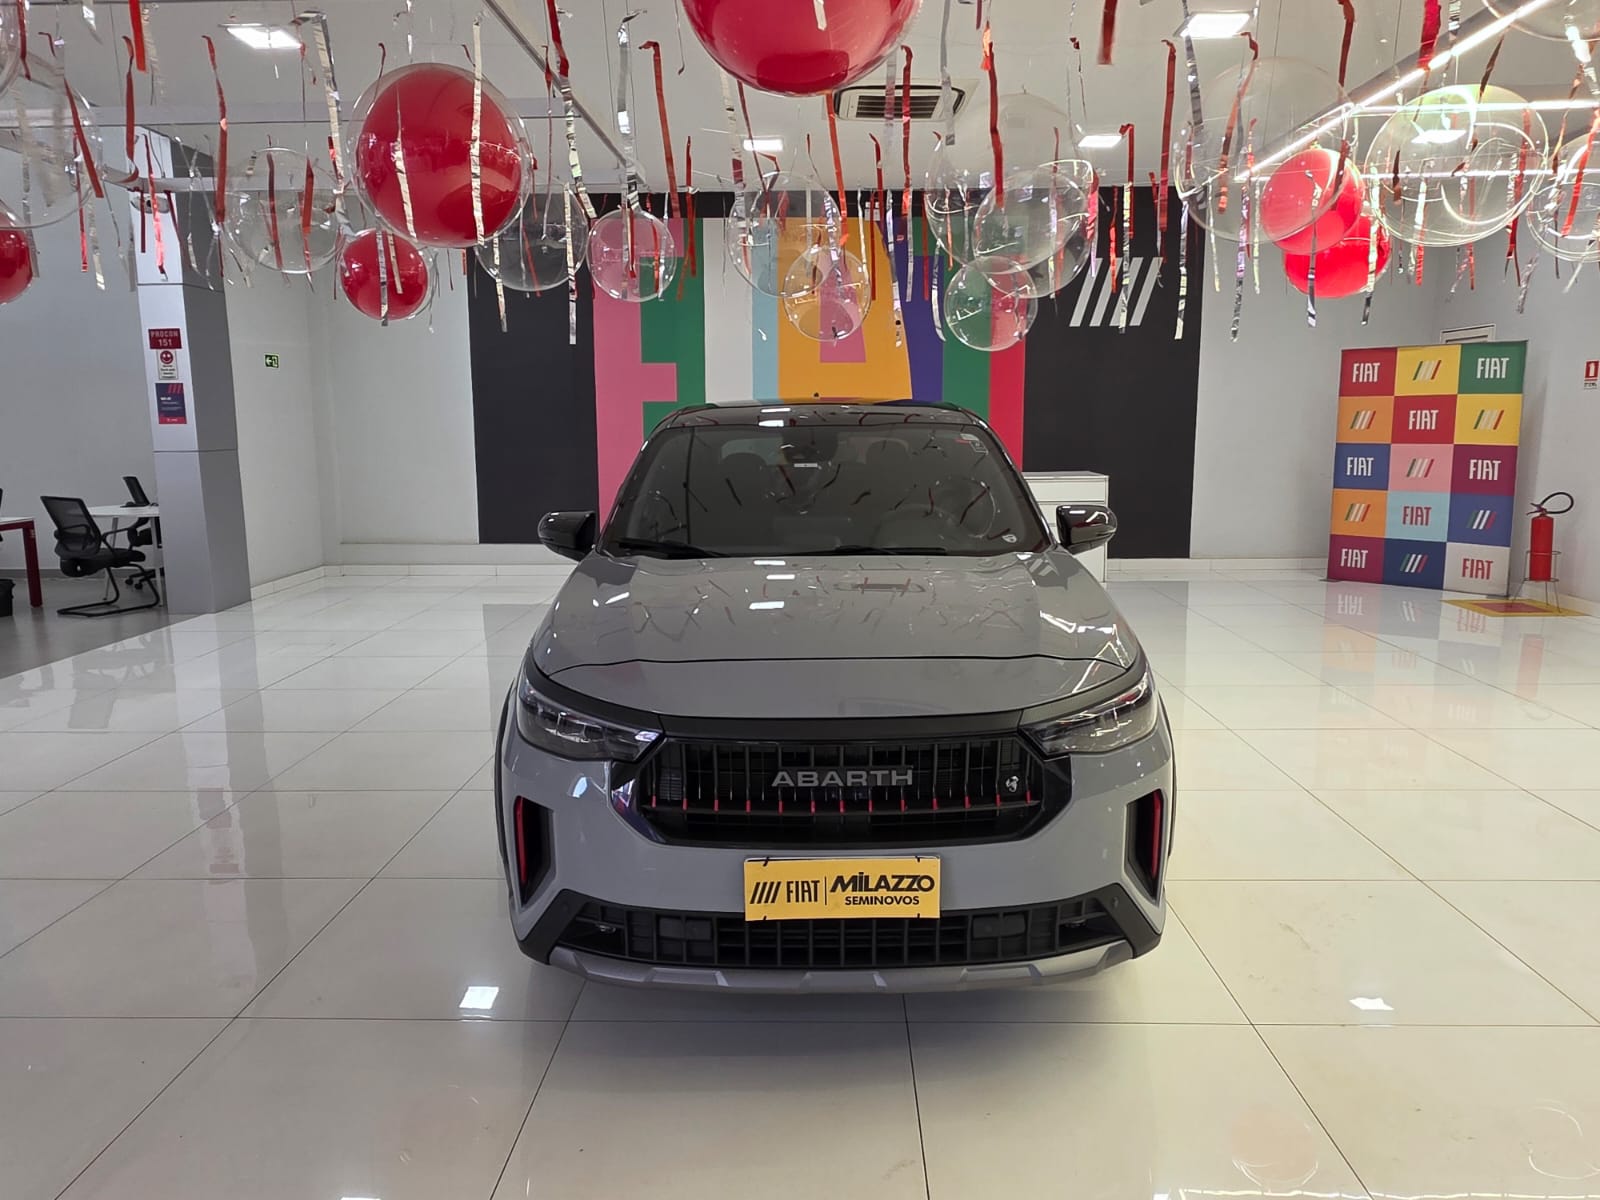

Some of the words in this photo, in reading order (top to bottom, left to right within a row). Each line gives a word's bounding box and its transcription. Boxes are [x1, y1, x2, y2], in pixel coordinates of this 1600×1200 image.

[1352, 362, 1380, 382] FIAT
[1476, 358, 1509, 379] FIAT
[1409, 410, 1439, 430] FIAT
[1346, 457, 1374, 476] FIAT
[1469, 459, 1501, 481] FIAT
[1402, 506, 1432, 526] FIAT
[1340, 549, 1368, 568] FIAT
[1462, 558, 1494, 580] FIAT
[771, 770, 912, 787] ABARTH
[786, 880, 820, 904] FIAT
[844, 895, 920, 905] SEMINOVOS
